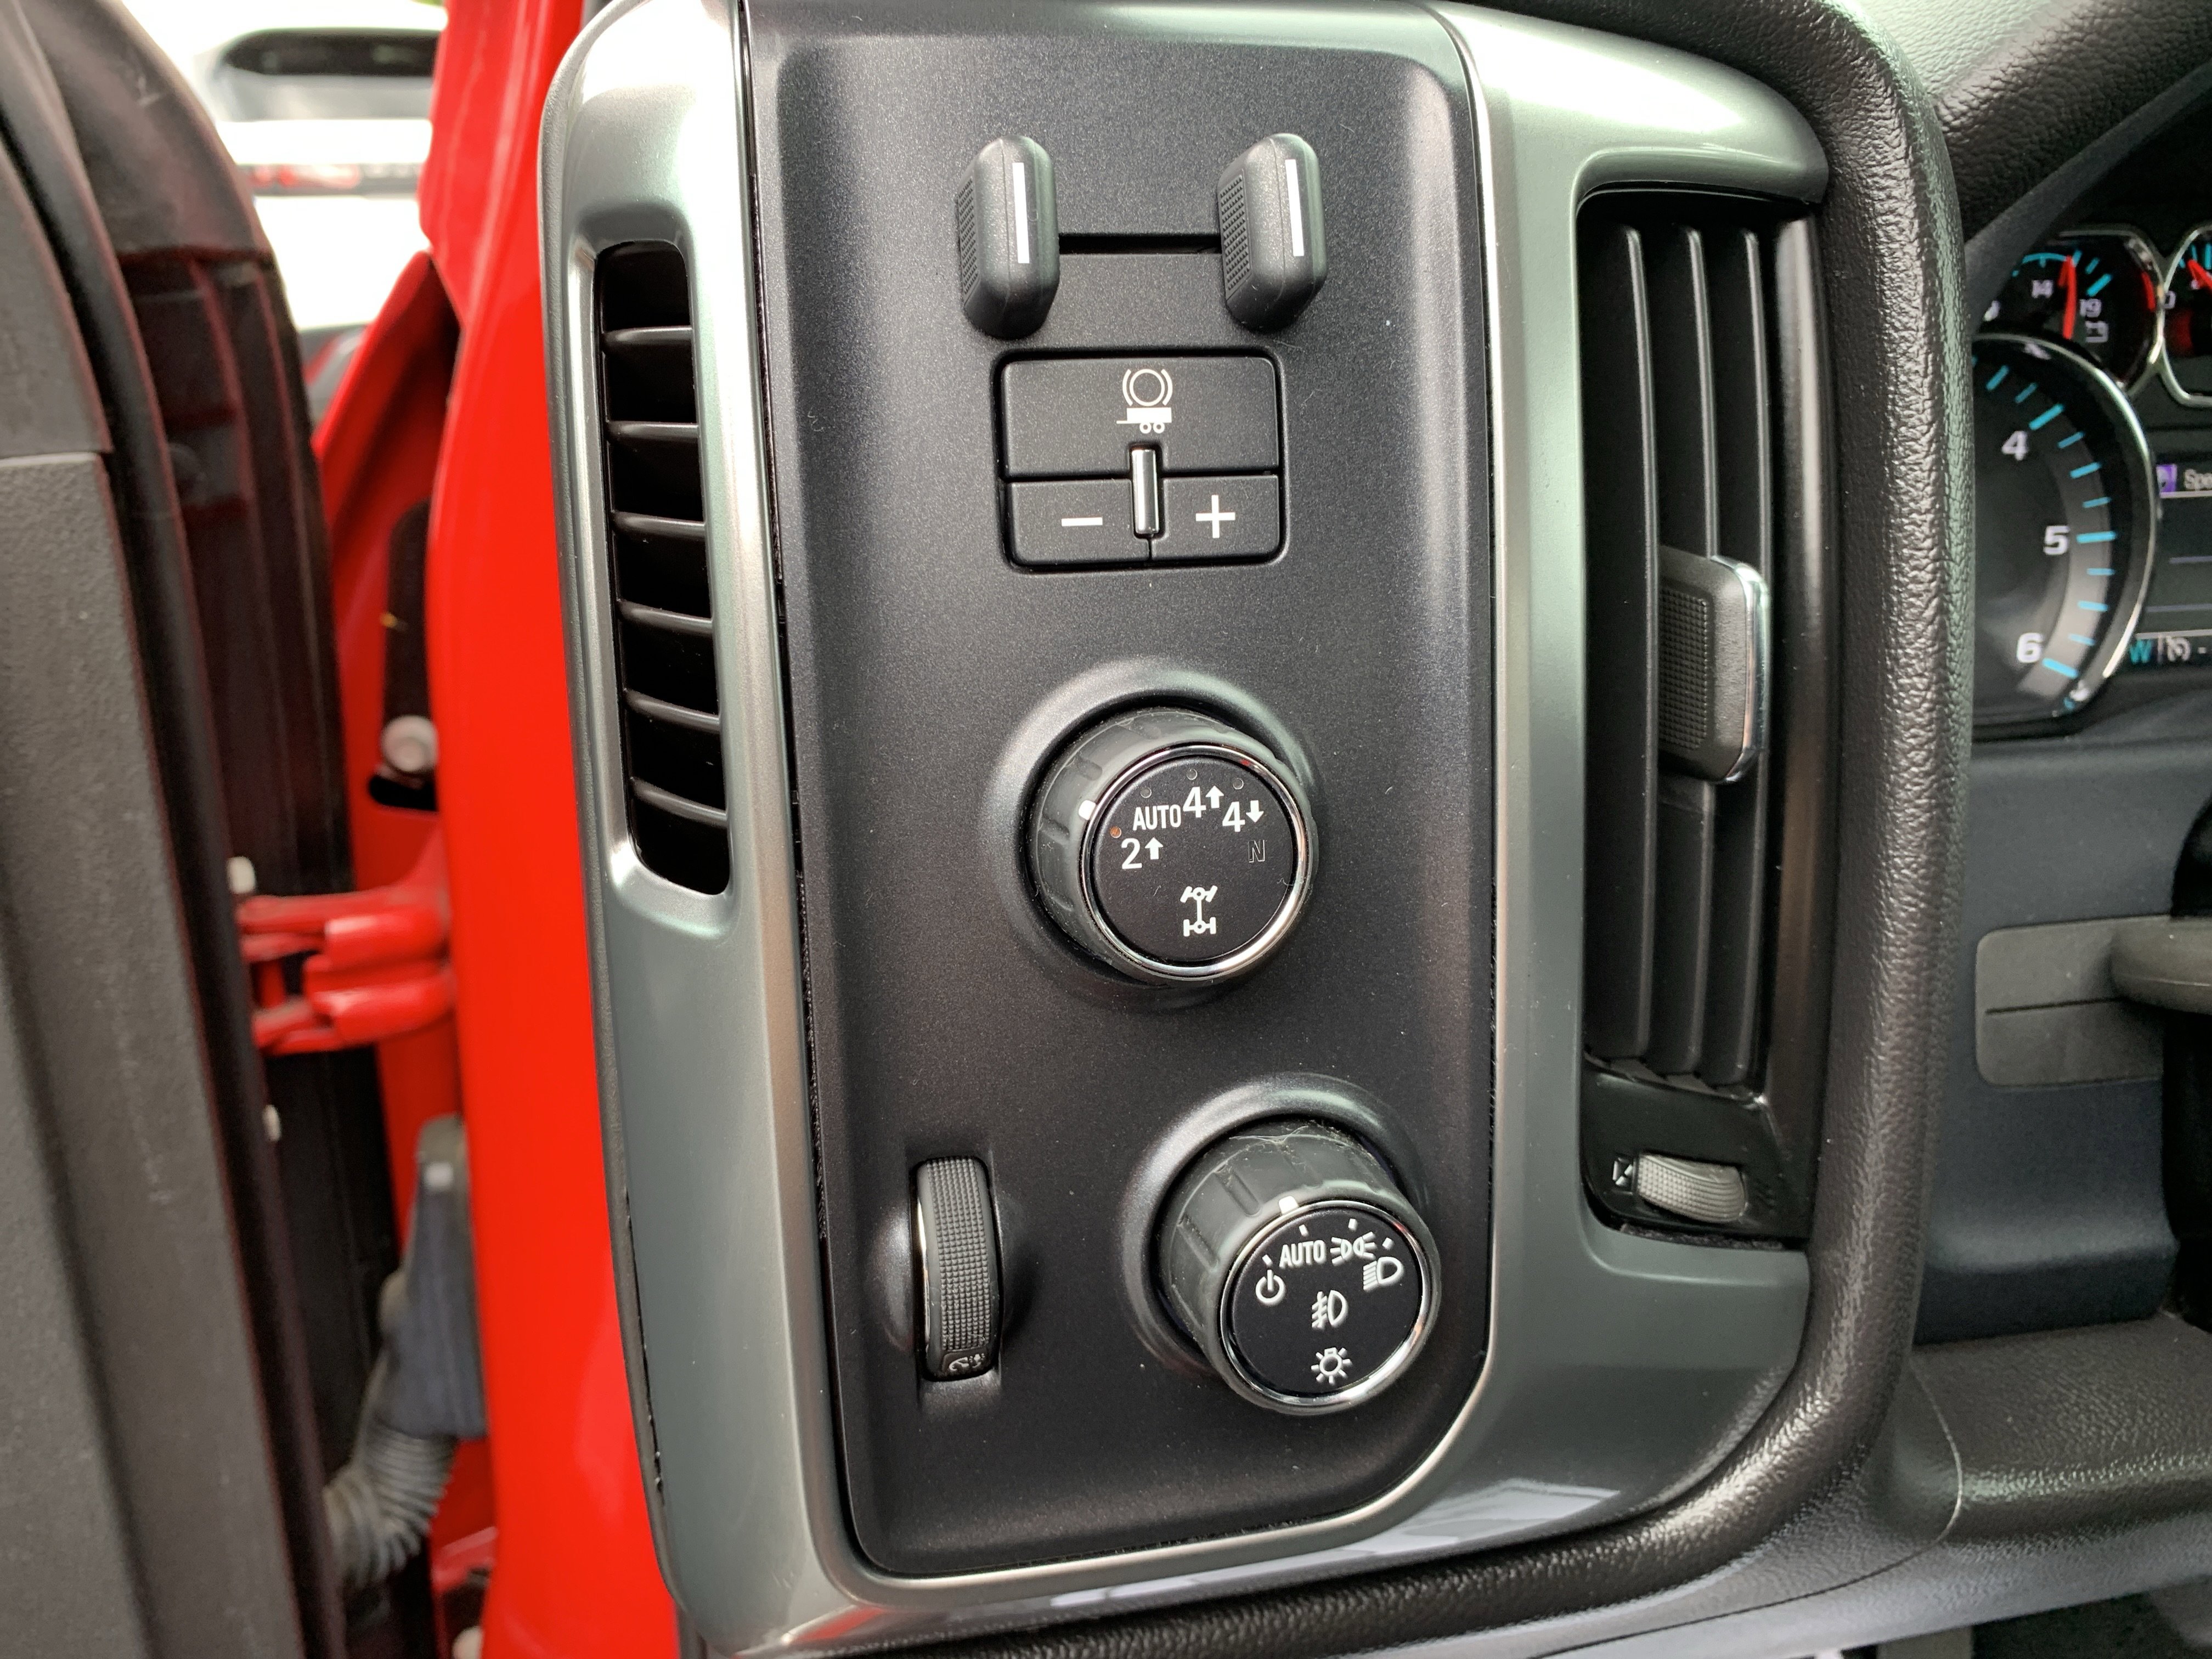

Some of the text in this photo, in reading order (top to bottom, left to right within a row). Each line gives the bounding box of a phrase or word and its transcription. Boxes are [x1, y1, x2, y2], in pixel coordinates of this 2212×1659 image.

[2001, 431, 2028, 460] 4
[2043, 525, 2070, 555] 5
[2017, 633, 2042, 663] 6
[2129, 639, 2152, 663] W
[1183, 787, 1206, 817] 4
[1133, 804, 1181, 831] AUTO
[1222, 802, 1245, 832] 4
[1121, 838, 1142, 869] 2
[1248, 839, 1266, 862] N
[1279, 1240, 1327, 1268] AUTO
